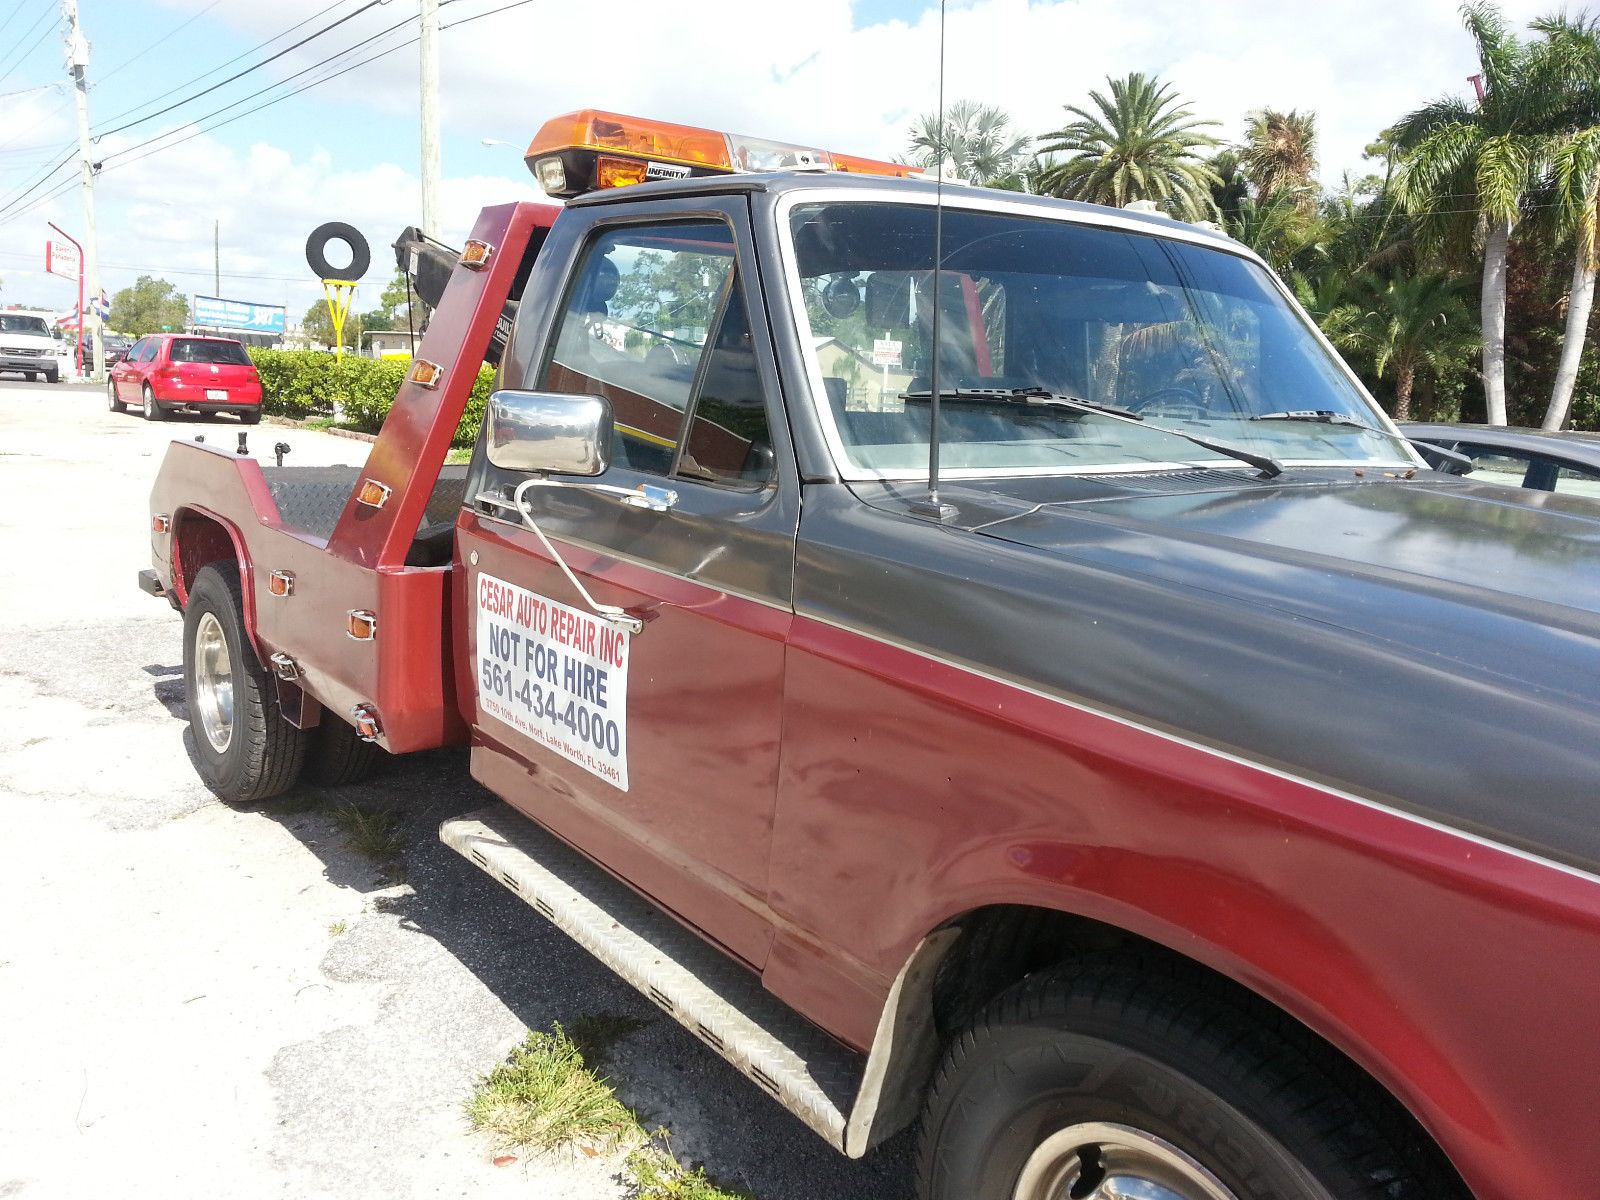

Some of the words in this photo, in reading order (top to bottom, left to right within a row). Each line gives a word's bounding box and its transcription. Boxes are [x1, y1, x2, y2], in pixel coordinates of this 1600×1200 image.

[648, 167, 686, 178] INFINITY
[480, 578, 513, 621] CESAR
[516, 593, 547, 635] AUTO
[550, 606, 595, 657] REPAIR
[599, 626, 624, 668] INC
[490, 622, 520, 667] NOT
[525, 638, 558, 686] FOR
[564, 655, 608, 709] HIRE
[482, 657, 619, 757] 561-434-4000
[501, 706, 514, 722] 10th
[546, 731, 562, 750] Lake
[563, 741, 586, 766] Worth,
[598, 760, 620, 782] 33461
